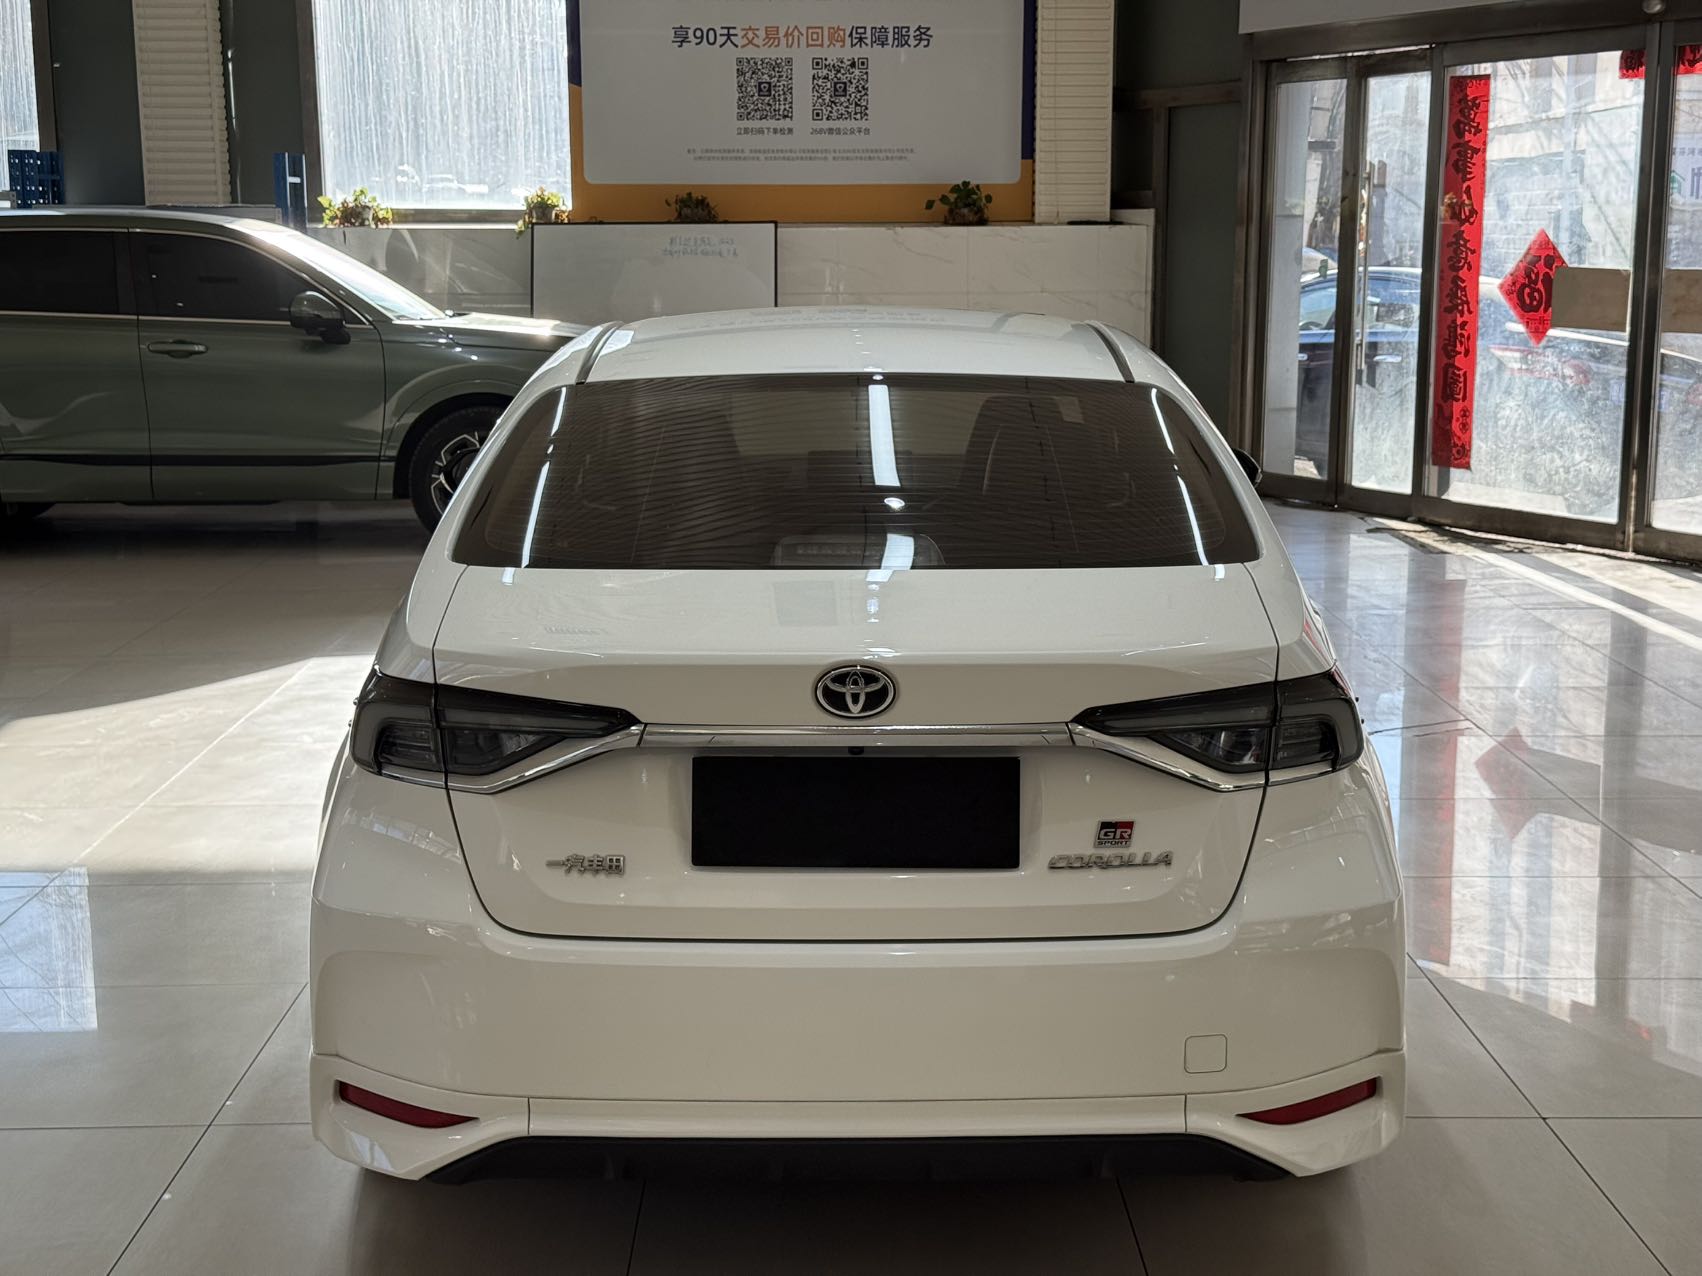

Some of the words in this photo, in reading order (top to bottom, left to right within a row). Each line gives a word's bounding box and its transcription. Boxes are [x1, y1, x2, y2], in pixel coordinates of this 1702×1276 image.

[671, 25, 933, 49] 享90天交易价回购保障服务
[1099, 828, 1132, 840] GR
[545, 853, 626, 877] 一汽丰田
[1048, 850, 1174, 869] COROLLA
